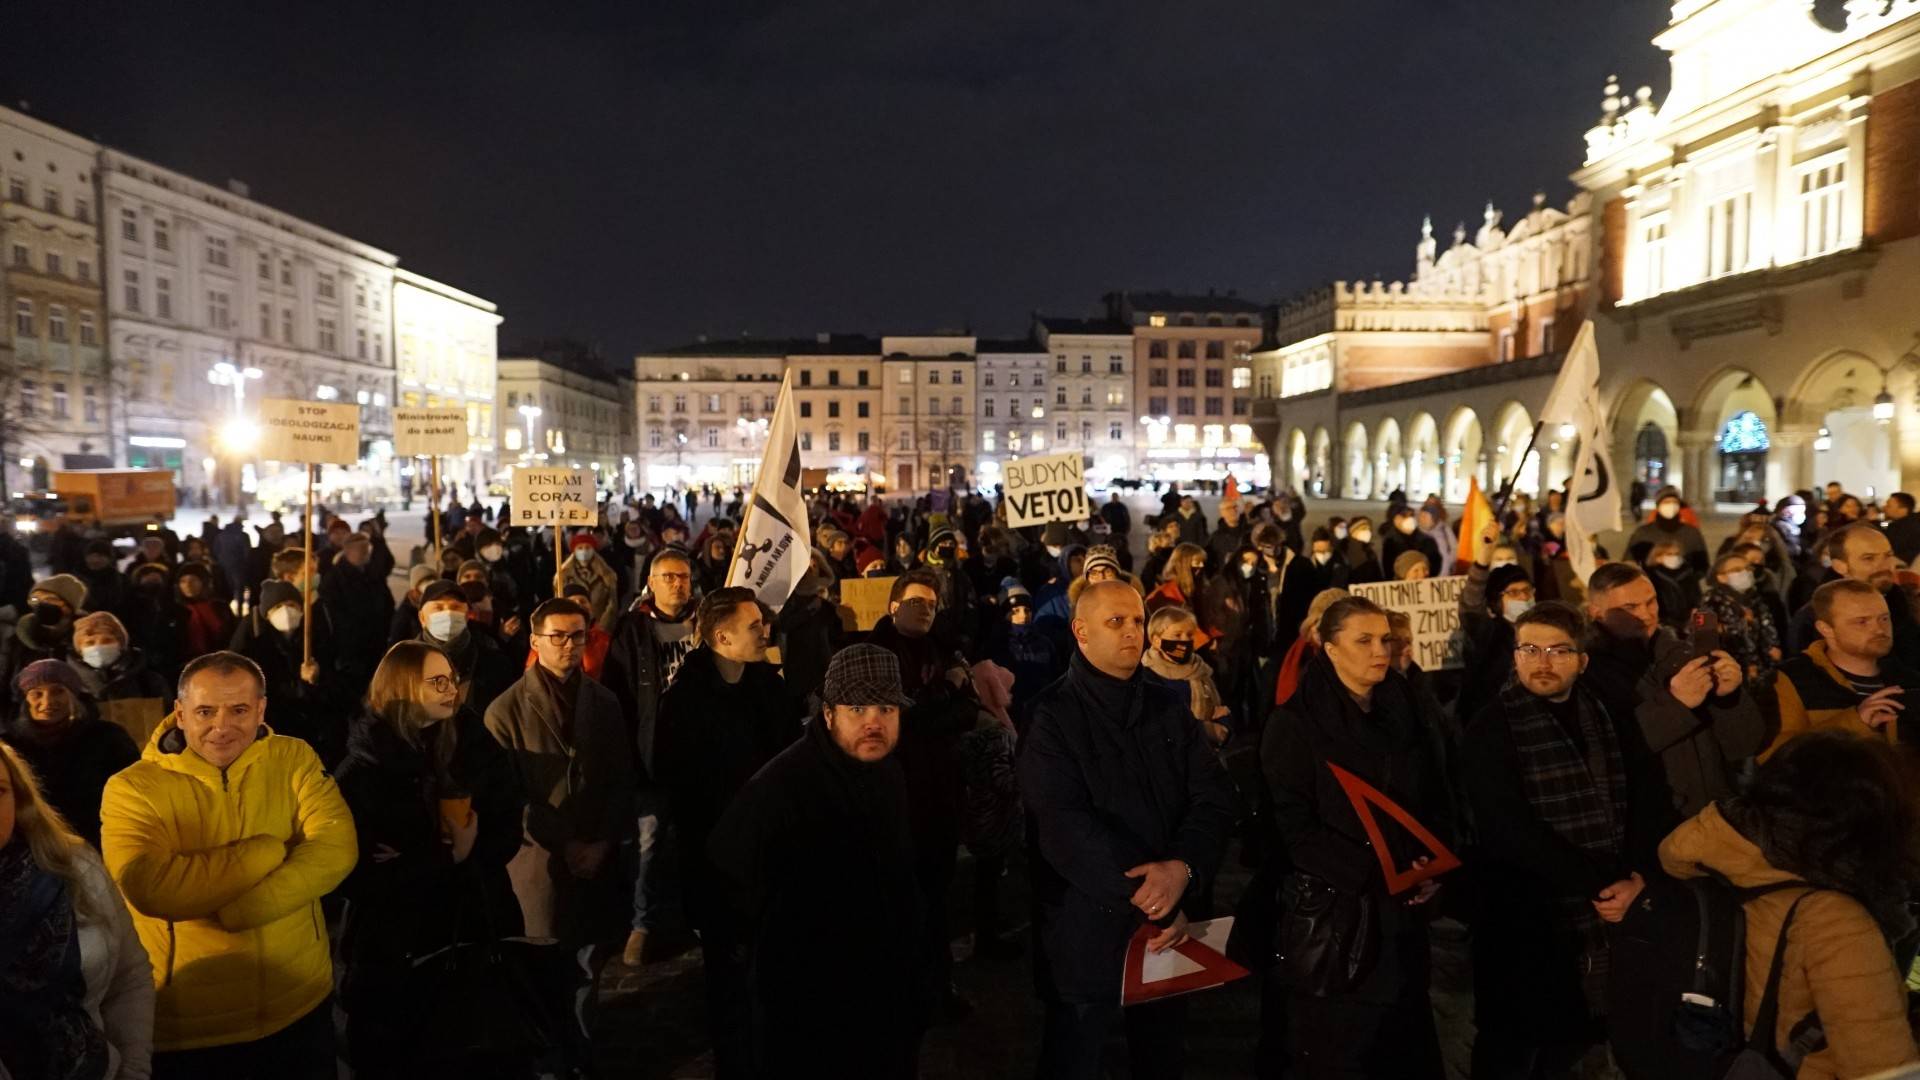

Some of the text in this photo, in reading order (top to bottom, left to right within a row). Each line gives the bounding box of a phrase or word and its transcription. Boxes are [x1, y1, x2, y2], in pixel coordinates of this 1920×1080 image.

[298, 407, 327, 415] STOP
[269, 418, 355, 431] IDEOLOGIZACJI
[528, 474, 582, 486] PISLAM
[529, 492, 582, 502] CORAZ
[1008, 486, 1084, 519] VETO!
[1390, 581, 1425, 606] MNIE
